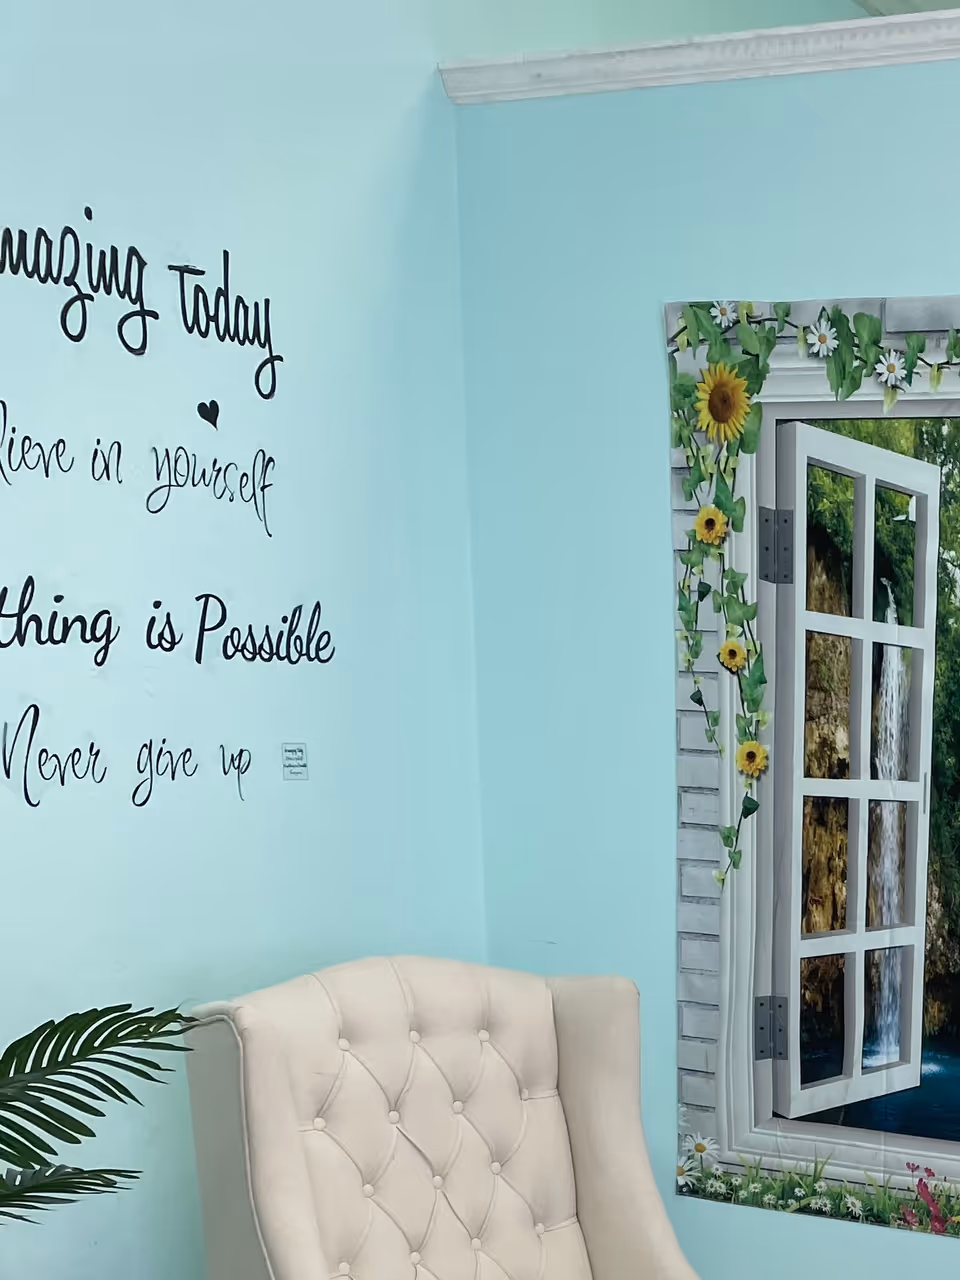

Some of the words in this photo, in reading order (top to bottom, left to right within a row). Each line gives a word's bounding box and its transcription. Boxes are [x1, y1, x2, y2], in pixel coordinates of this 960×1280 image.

[167, 250, 284, 399] Today
[92, 438, 123, 484] in
[146, 446, 275, 537] yourself
[146, 600, 183, 652] is
[195, 594, 335, 665] Possible
[2, 704, 107, 807] Never
[132, 738, 198, 807] give
[219, 744, 251, 801] up
